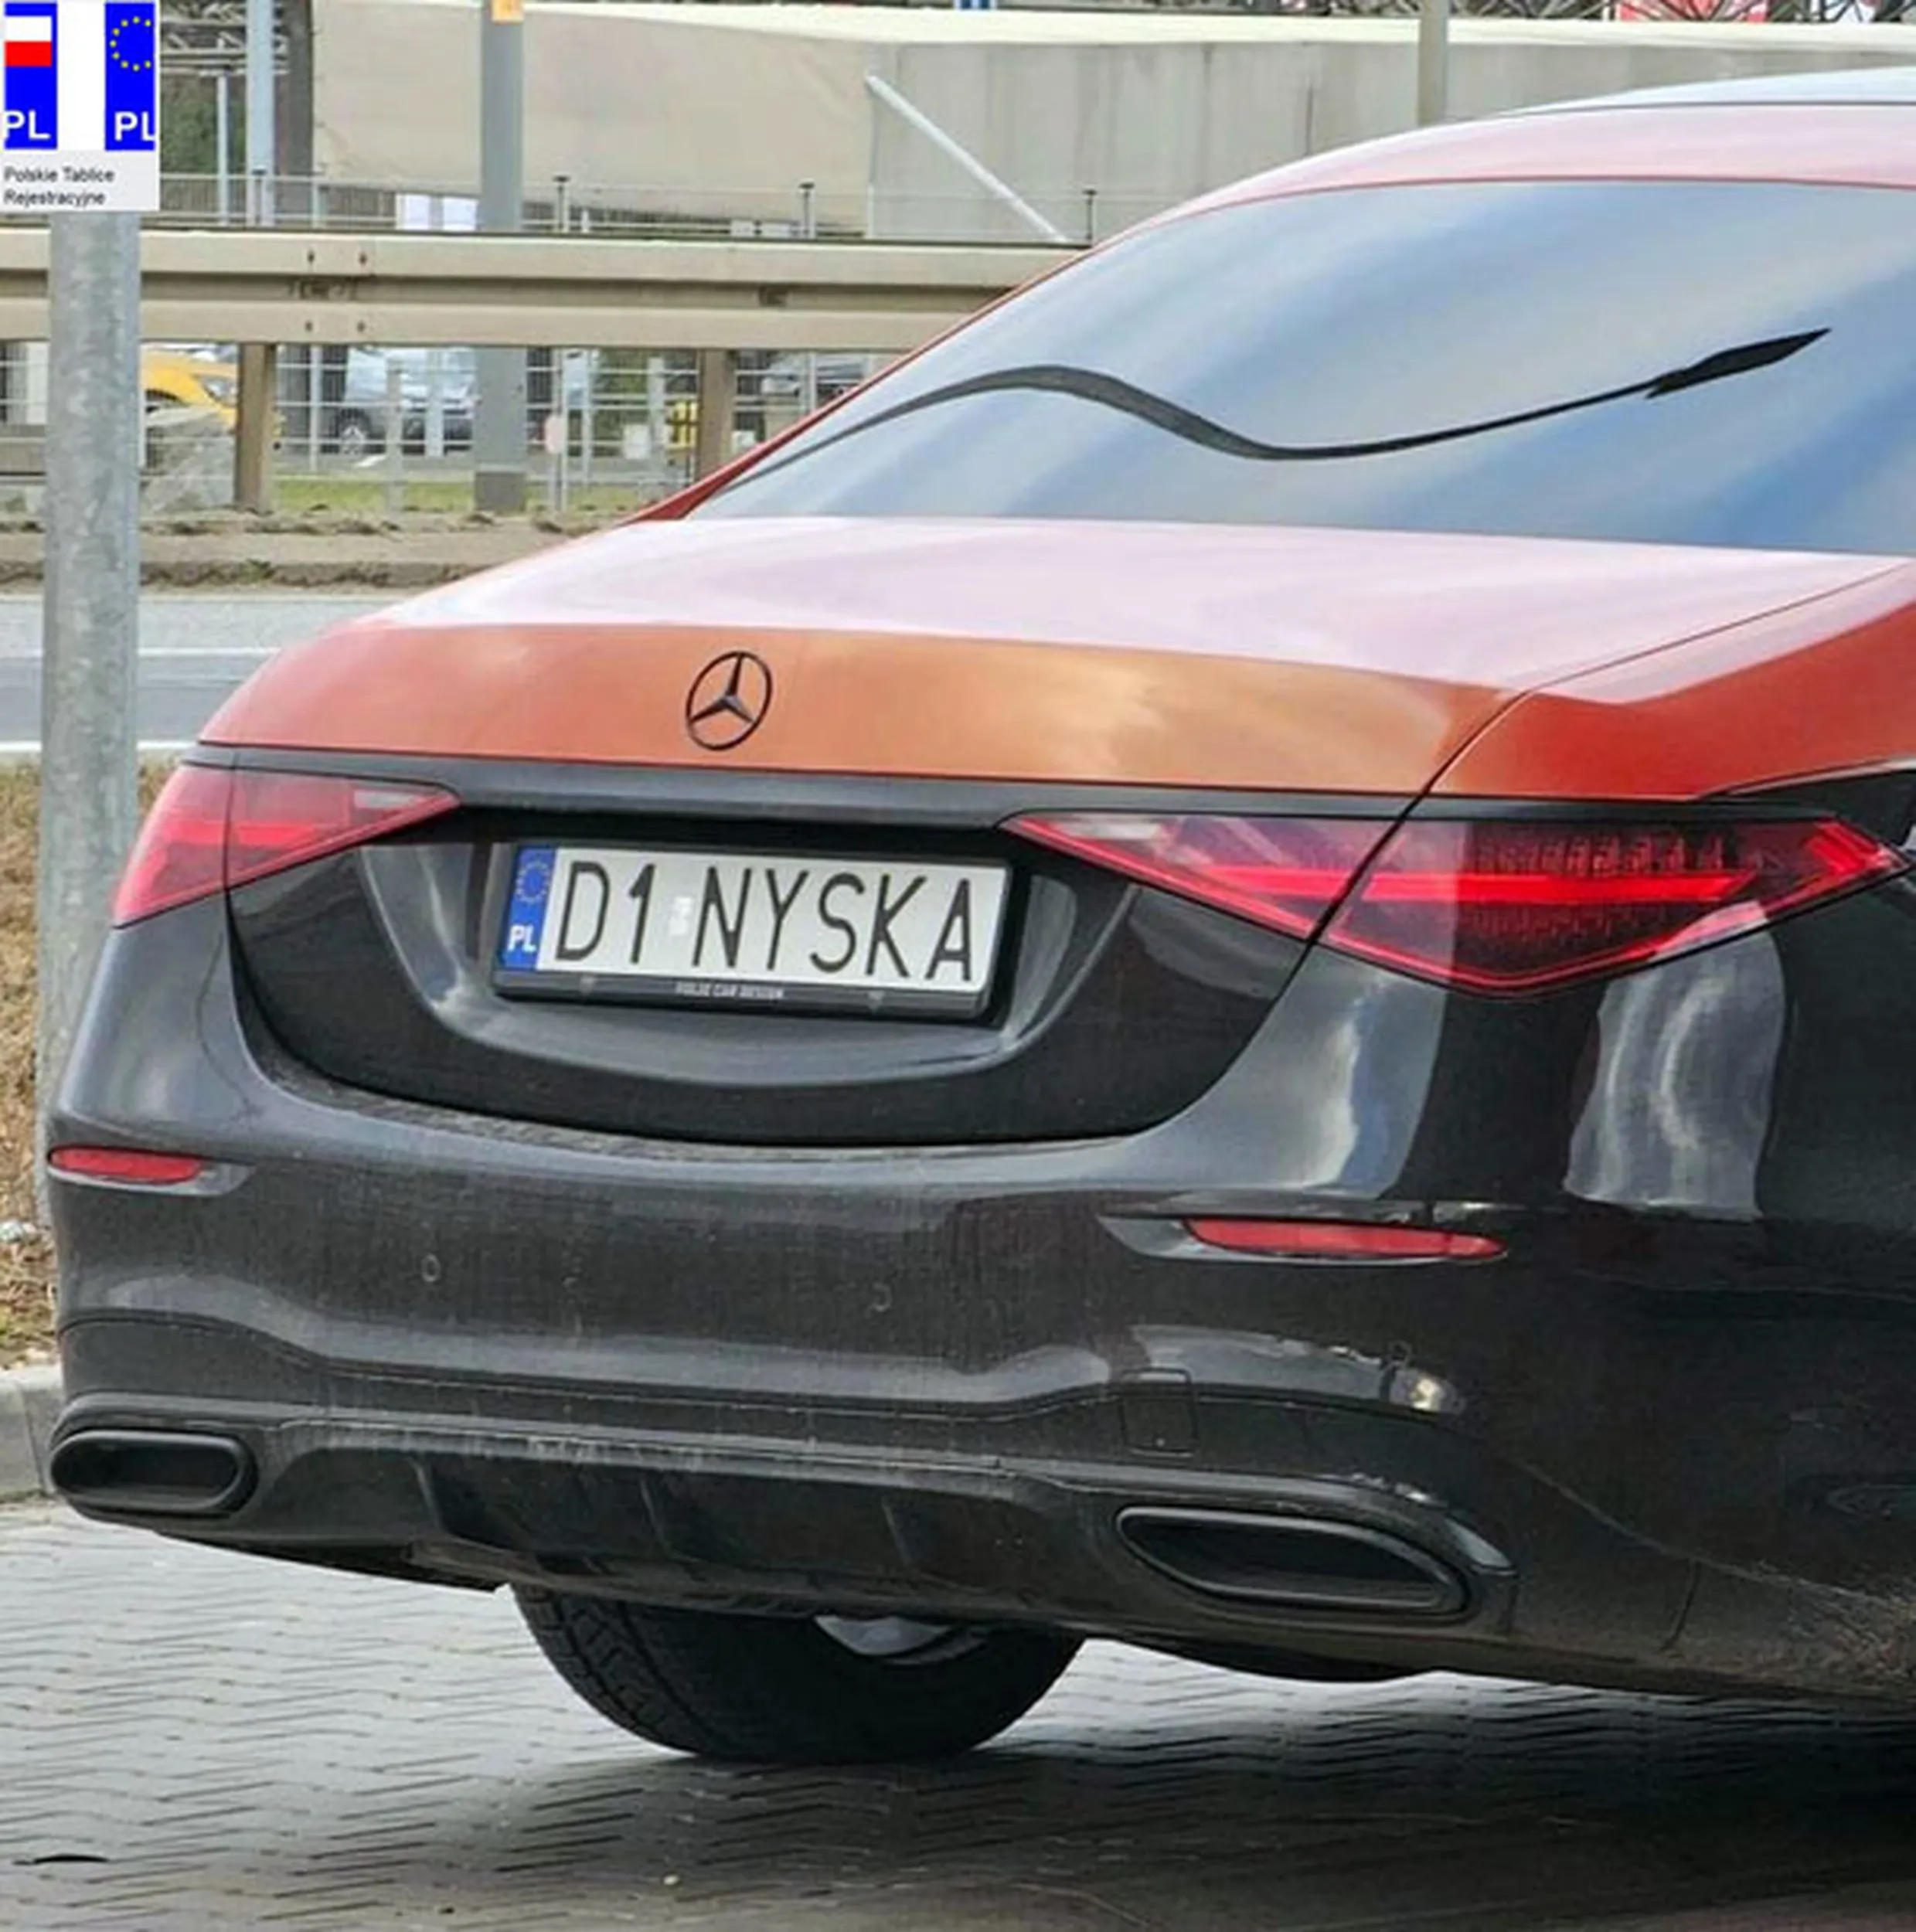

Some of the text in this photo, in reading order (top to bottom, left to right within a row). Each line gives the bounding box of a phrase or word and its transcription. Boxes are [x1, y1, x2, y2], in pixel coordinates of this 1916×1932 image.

[506, 923, 538, 953] PL
[555, 860, 972, 981] D1 NYSKA
